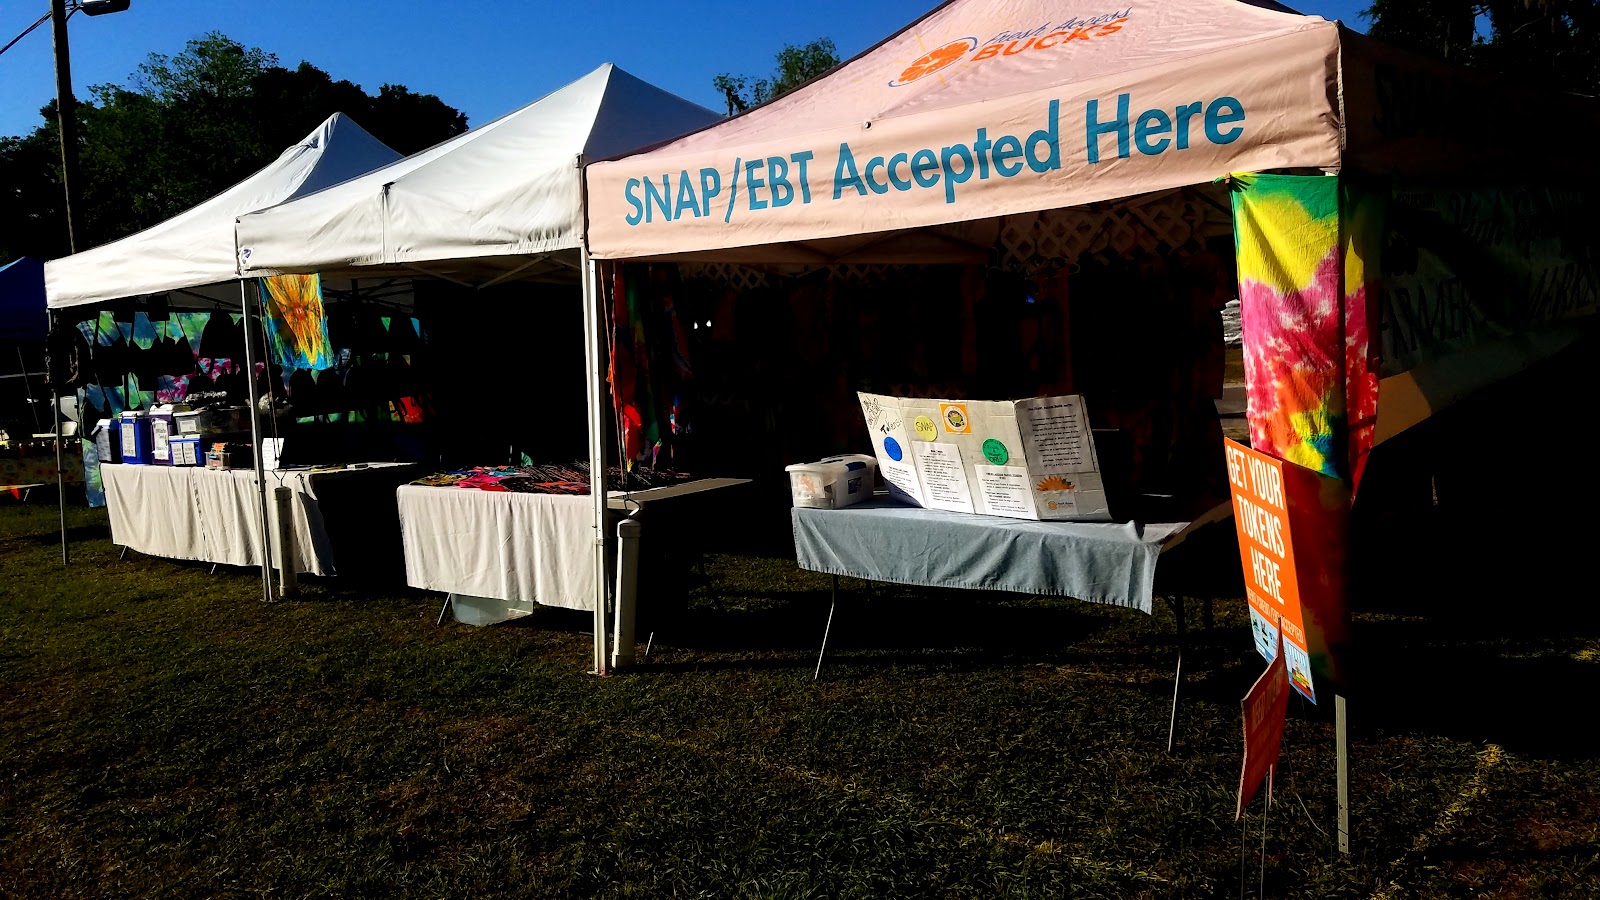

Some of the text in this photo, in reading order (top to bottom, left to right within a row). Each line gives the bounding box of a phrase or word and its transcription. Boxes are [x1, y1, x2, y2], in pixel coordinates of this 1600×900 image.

[969, 17, 1130, 62] BUCKS
[981, 21, 1050, 46] Fresh
[624, 93, 1246, 226] SNAP/EBT Accepted Here
[1227, 444, 1284, 511] GET YOUR
[1236, 493, 1285, 560] TOKENS
[1249, 546, 1285, 606] HERE
